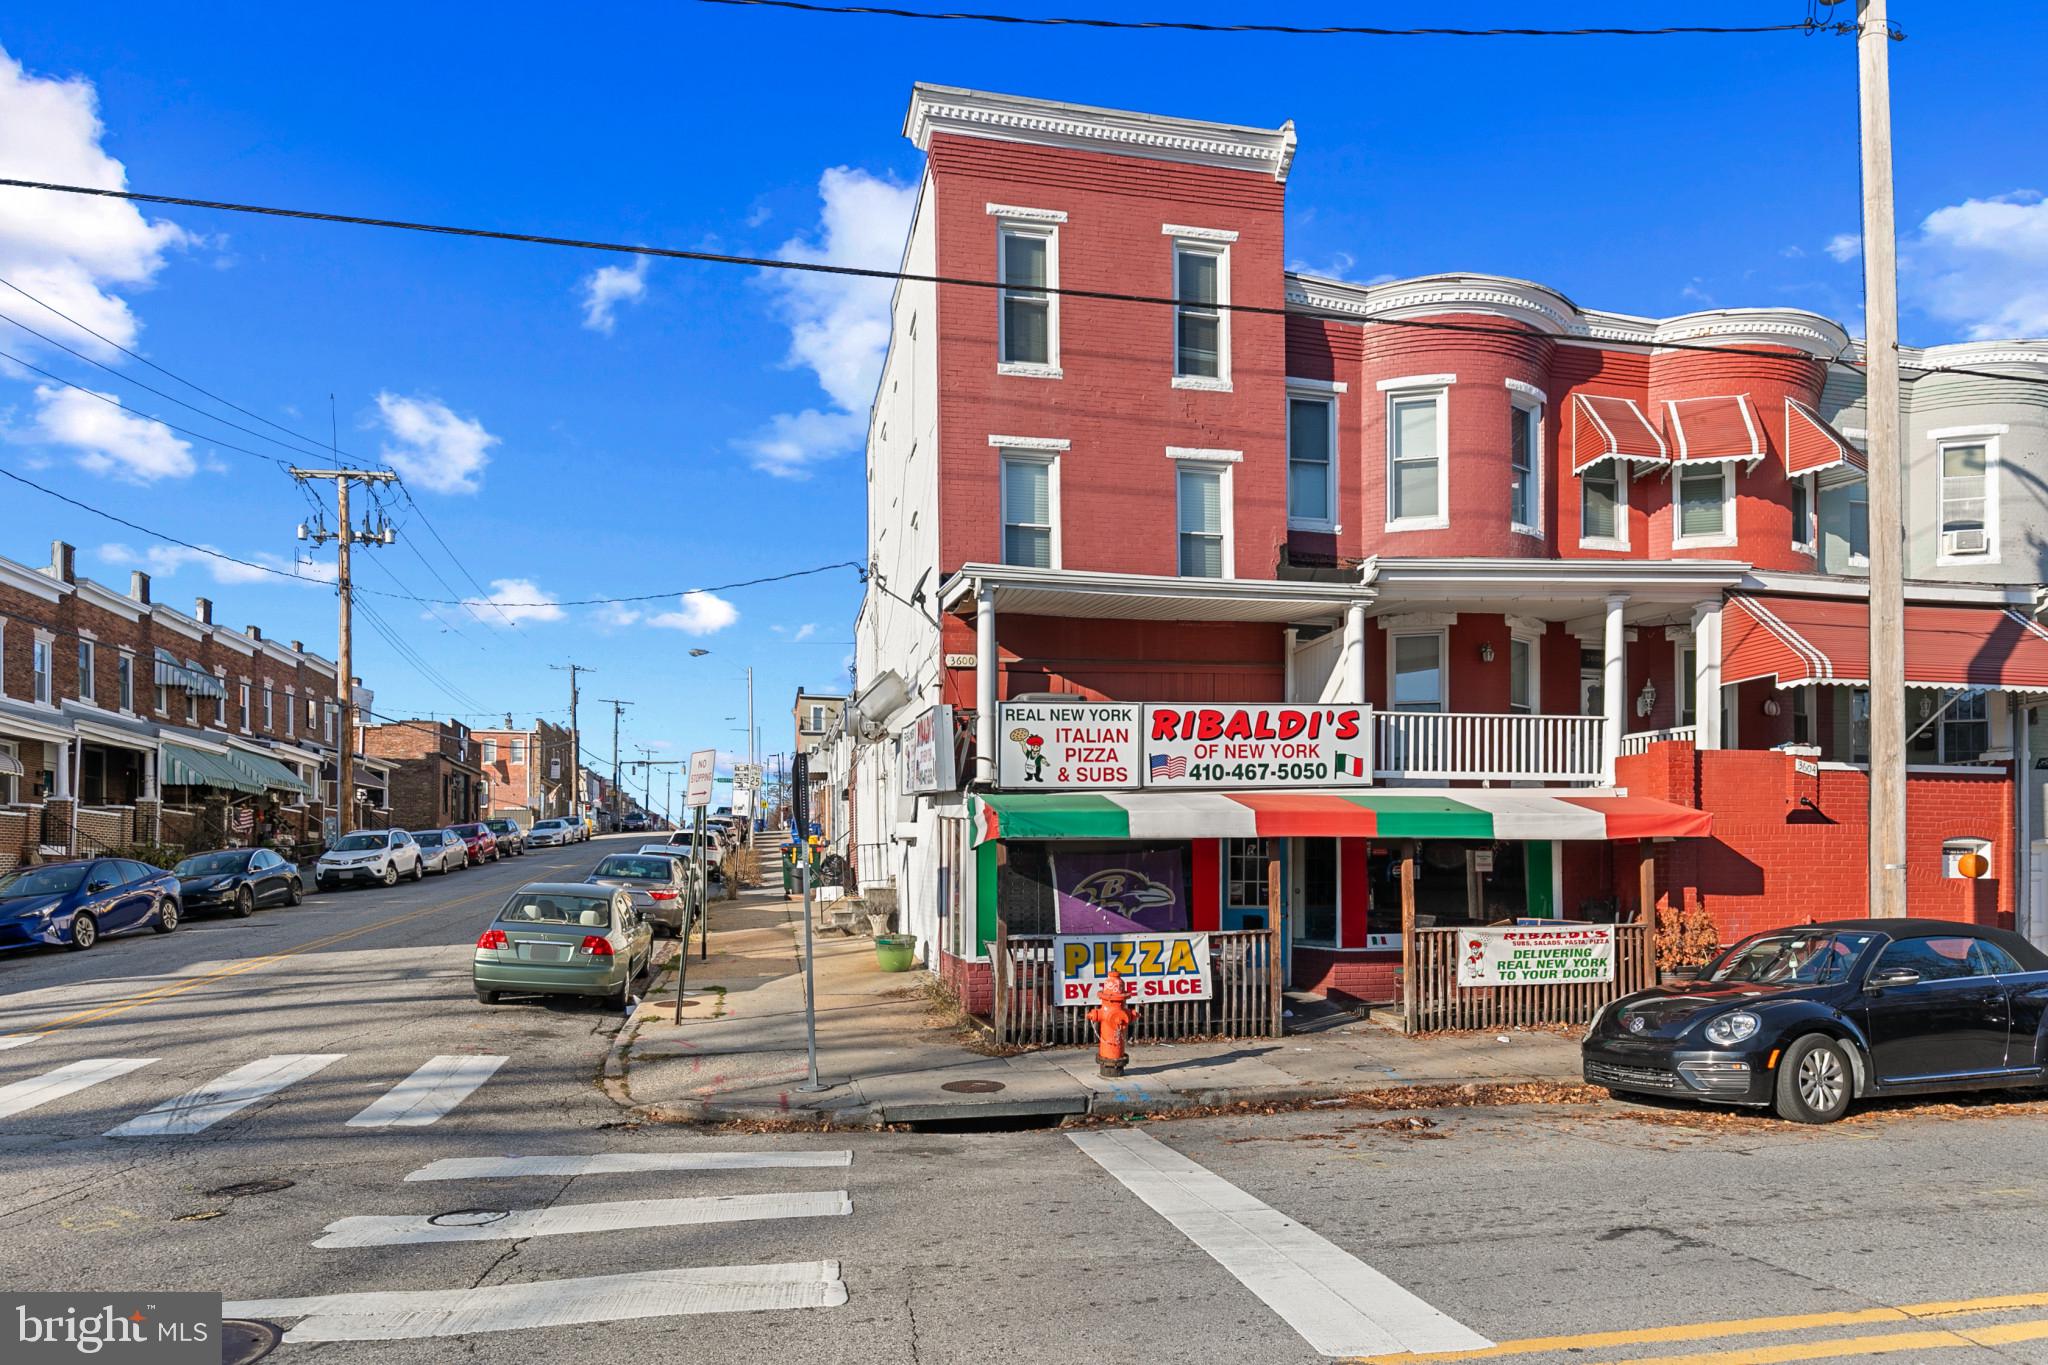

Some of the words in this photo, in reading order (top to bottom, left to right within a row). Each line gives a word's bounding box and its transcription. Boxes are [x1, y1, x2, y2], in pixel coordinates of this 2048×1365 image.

[950, 656, 974, 666] 3600
[1005, 708, 1046, 722] REAL
[1050, 708, 1085, 722] NEW
[1089, 708, 1132, 722] YORK
[1152, 709, 1360, 741] RIBALDI'S
[1056, 728, 1129, 744] ITALIAN
[1065, 748, 1119, 763] PIZZA
[1194, 744, 1220, 759] OF
[1224, 744, 1264, 759] NEW
[1270, 743, 1320, 758] YORK
[698, 759, 706, 768] NO
[1798, 760, 1816, 774] 3604
[1058, 767, 1070, 782] &
[1076, 767, 1128, 782] SUBS
[1189, 763, 1328, 781] 410-467-5050
[750, 776, 760, 787] 25
[1064, 939, 1200, 979] PIZZA
[1514, 948, 1592, 960] DELIVERING
[1497, 960, 1532, 970] REAL
[1537, 959, 1568, 969] NEW
[1573, 958, 1608, 968] YORK
[1500, 971, 1516, 980] TO
[1523, 970, 1558, 980] YOUR
[1564, 970, 1599, 978] DOOR
[1065, 984, 1093, 999] BY
[1145, 979, 1202, 996] SLICE
